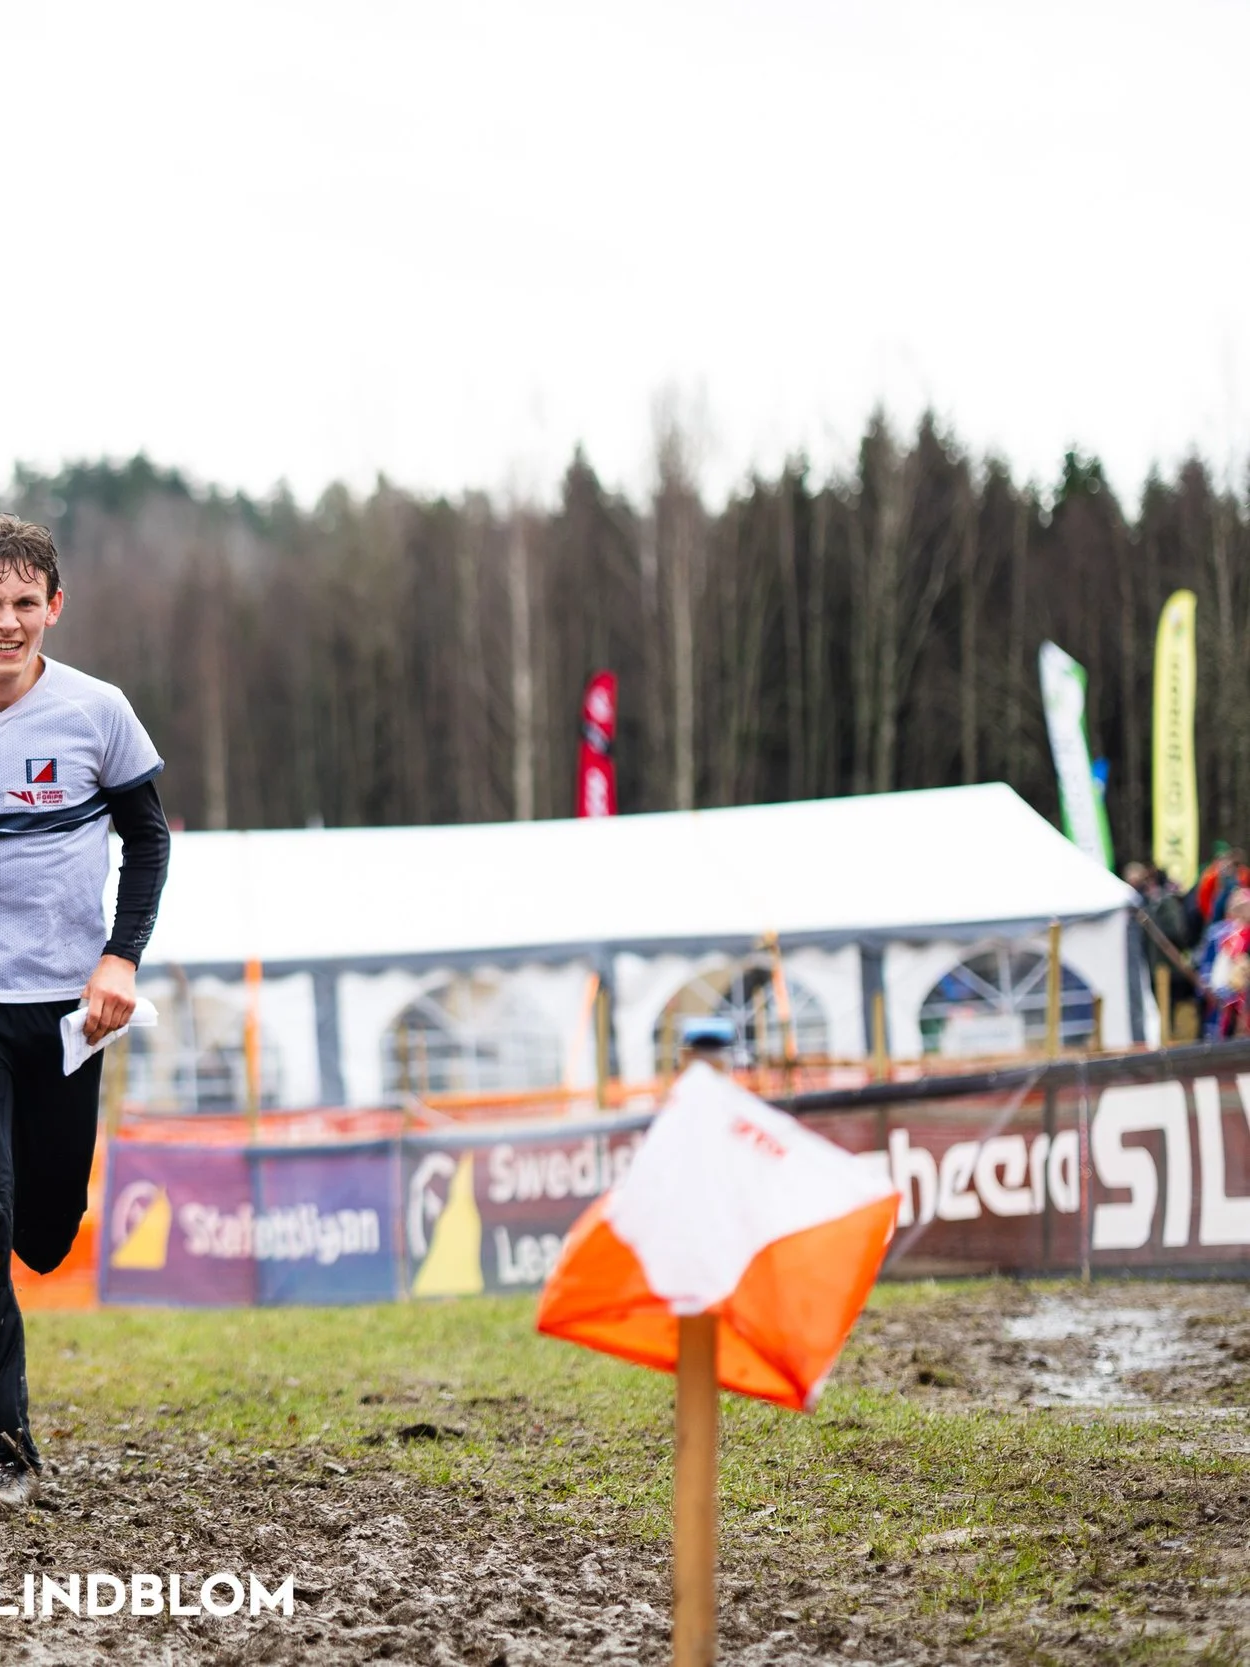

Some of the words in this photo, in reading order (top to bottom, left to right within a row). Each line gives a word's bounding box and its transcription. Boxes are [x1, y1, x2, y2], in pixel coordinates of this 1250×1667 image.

[488, 1130, 643, 1204] Swedis
[854, 1127, 1081, 1228] heera
[1091, 1072, 1250, 1249] SIL
[494, 1225, 566, 1285] Lea
